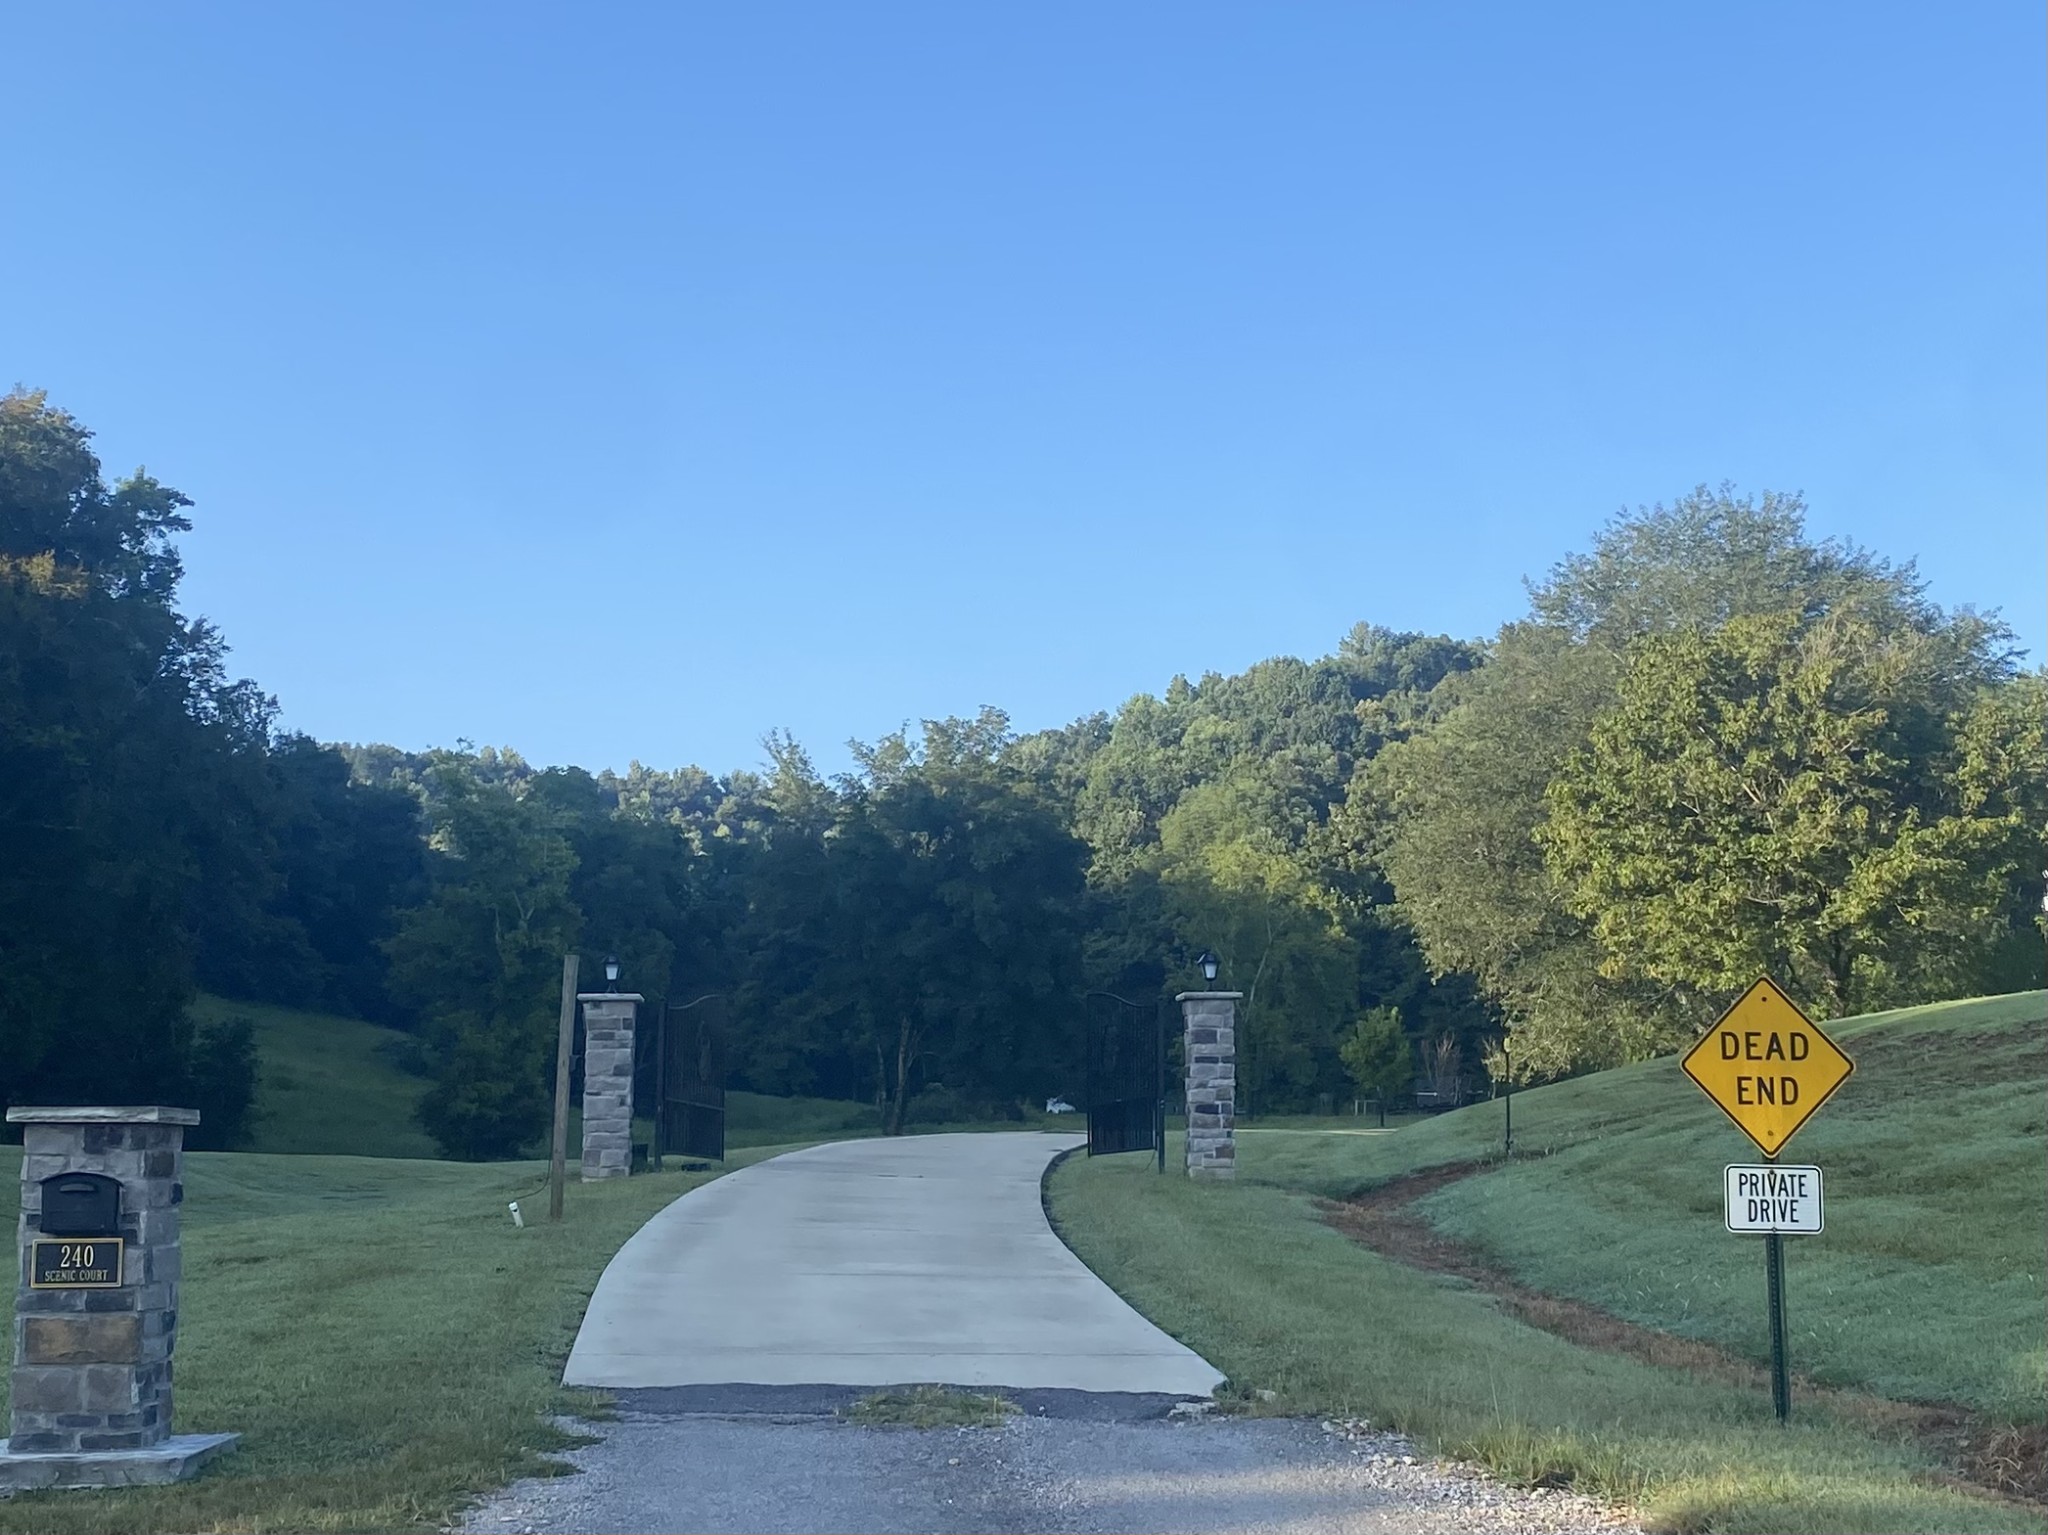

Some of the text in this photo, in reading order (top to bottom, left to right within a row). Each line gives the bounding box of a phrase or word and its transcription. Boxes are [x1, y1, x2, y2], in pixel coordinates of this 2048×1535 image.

[1720, 1031, 1809, 1061] DEAD
[1736, 1076, 1799, 1105] END
[1738, 1173, 1808, 1198] PRIVATE
[1748, 1199, 1799, 1223] DRIVE
[60, 1245, 94, 1267] 240
[44, 1269, 108, 1282] SCENIC COURT
